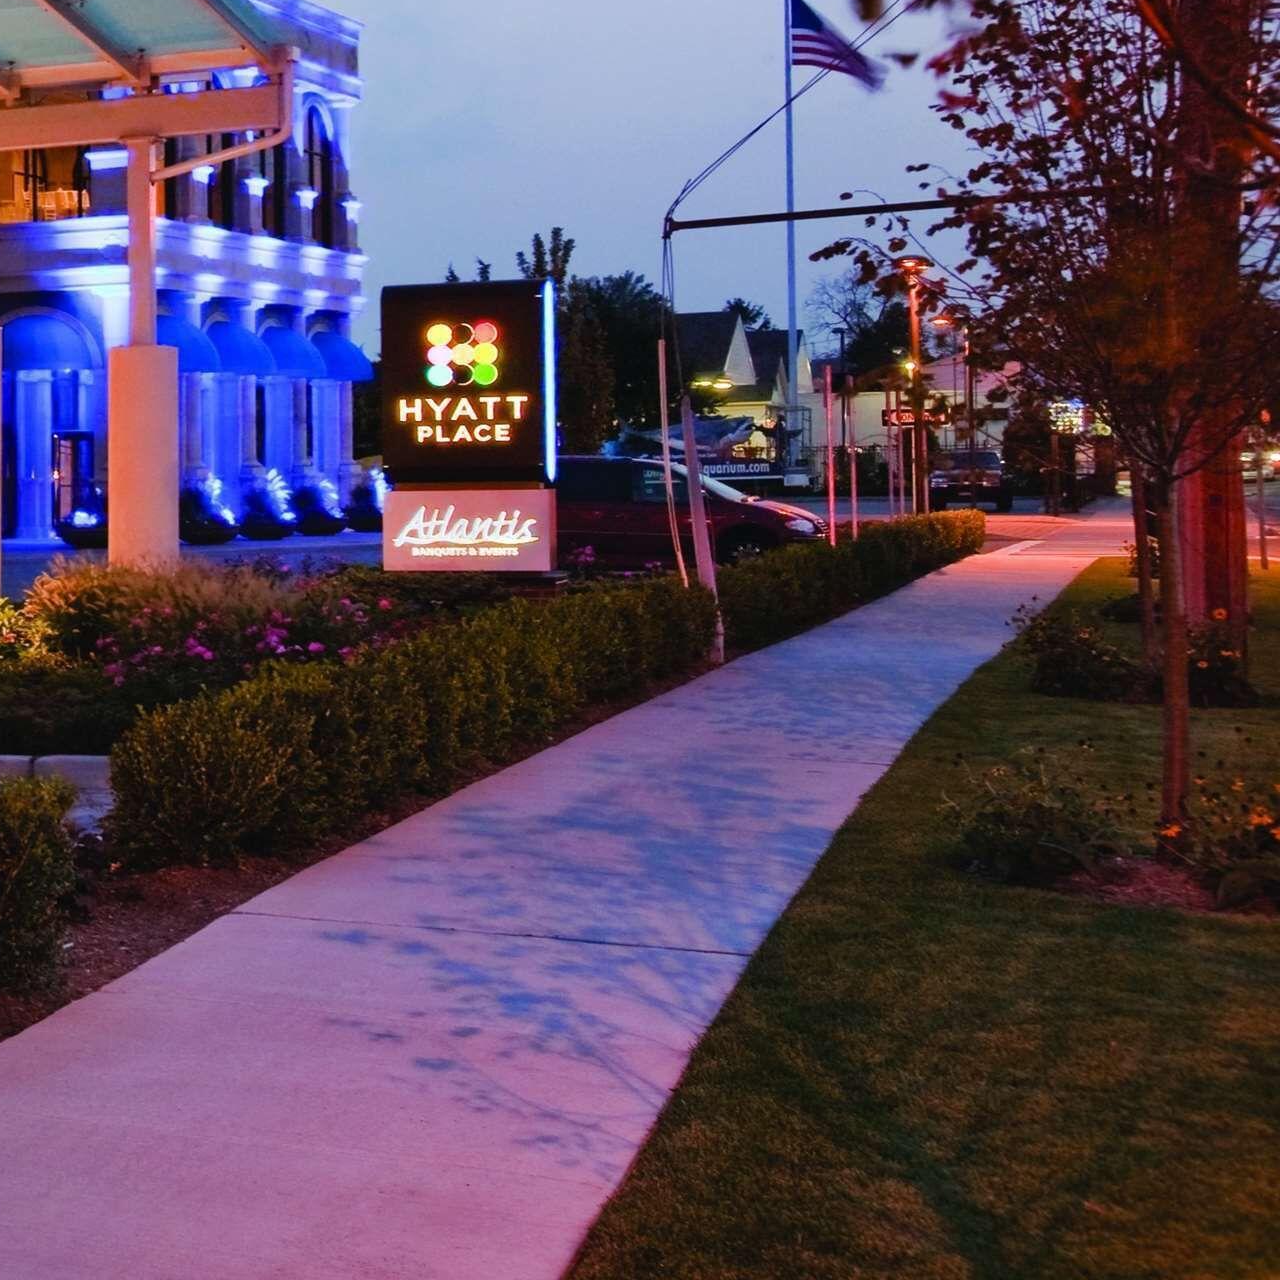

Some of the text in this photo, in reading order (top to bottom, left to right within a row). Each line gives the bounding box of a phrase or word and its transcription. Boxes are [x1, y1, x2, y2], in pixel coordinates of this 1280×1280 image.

[399, 396, 528, 422] HYATT
[416, 424, 511, 442] PLACE
[393, 505, 538, 547] Atlantis
[412, 547, 467, 557] BANQUETS
[479, 547, 519, 556] EVENTS
